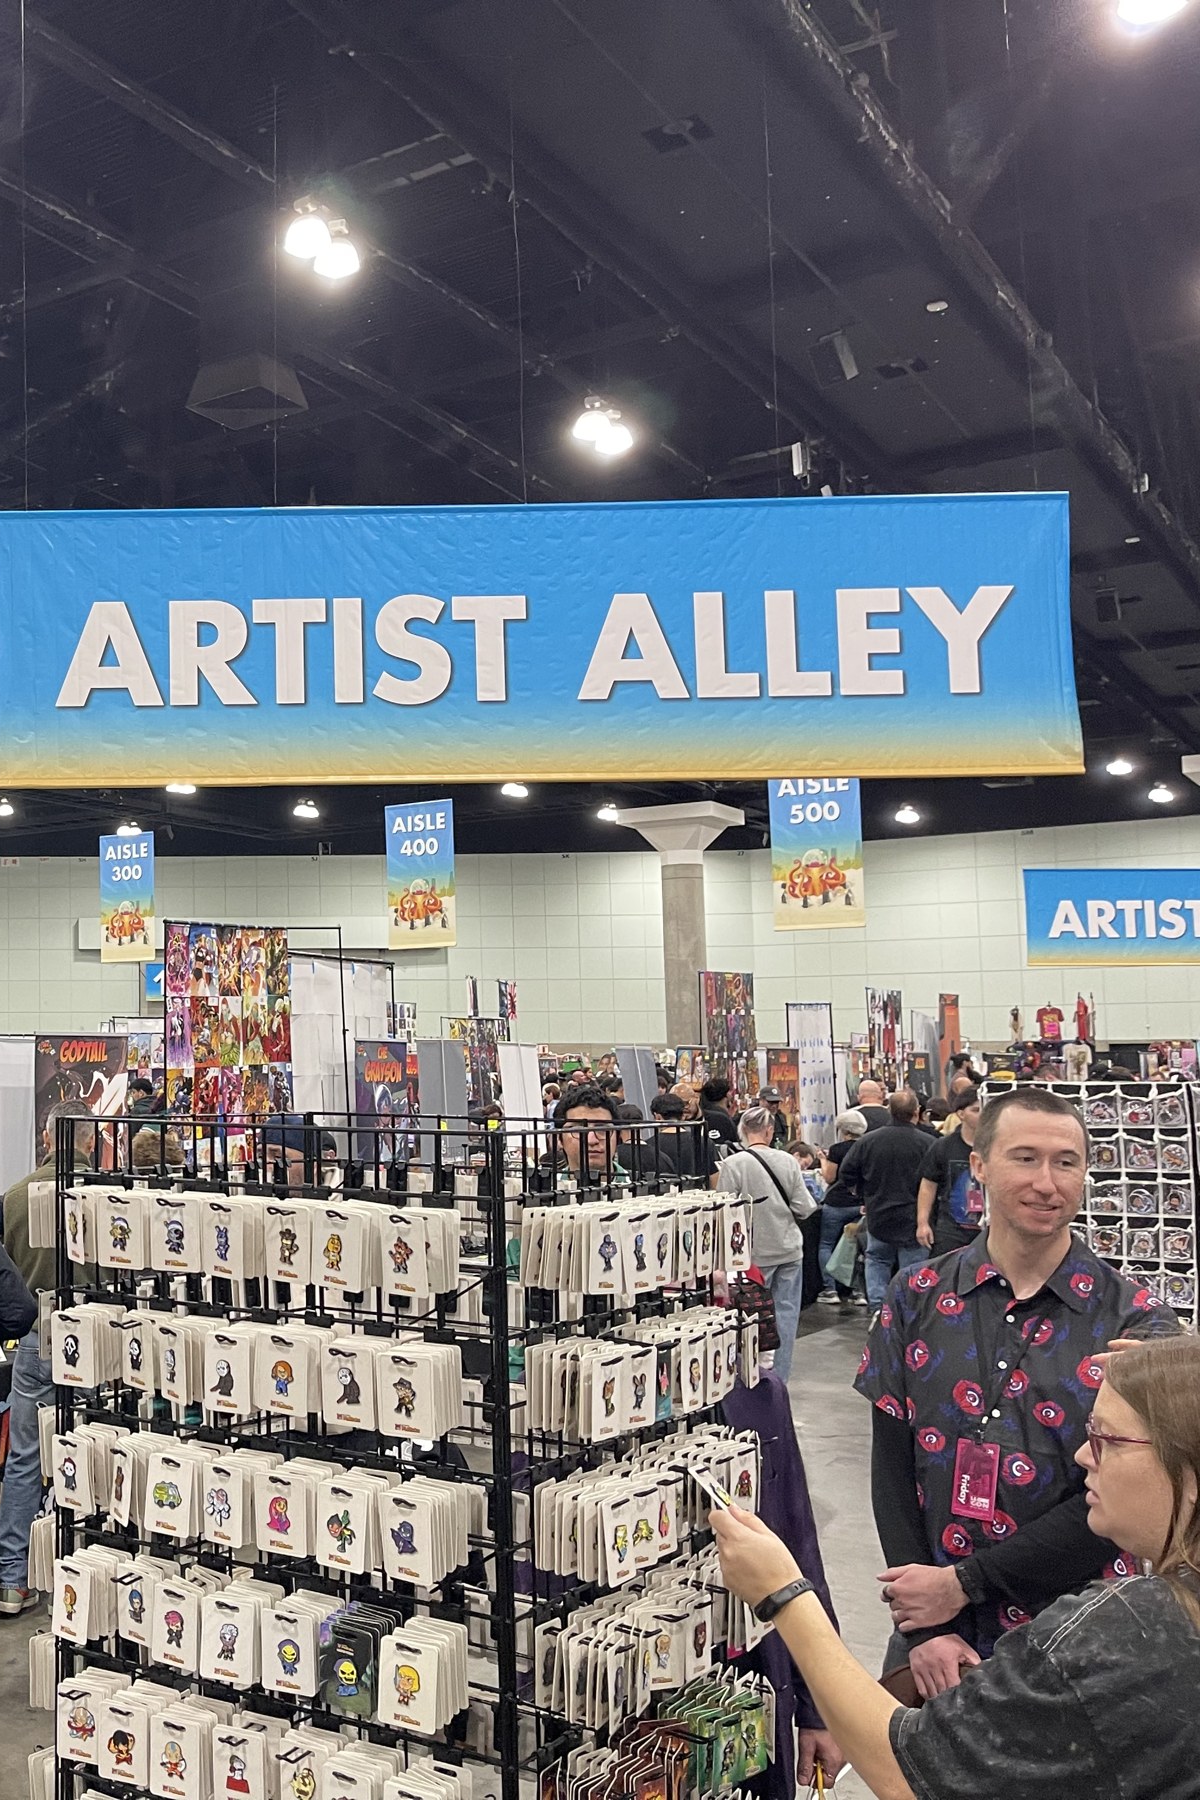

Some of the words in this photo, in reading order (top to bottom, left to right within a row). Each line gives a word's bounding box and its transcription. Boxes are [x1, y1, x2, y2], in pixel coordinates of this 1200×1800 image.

[56, 595, 528, 708] ARTIST
[577, 585, 1015, 702] ALLEY
[776, 778, 850, 798] AISLE
[392, 812, 446, 834] AISLE
[789, 800, 841, 824] 500
[105, 842, 148, 861] AISLE
[400, 838, 439, 857] 400
[111, 864, 142, 882] 300
[1048, 898, 1200, 939] ARTIST
[59, 1040, 108, 1064] GODTAIL
[364, 1060, 402, 1083] GRAYSON
[957, 1474, 970, 1505] Friday
